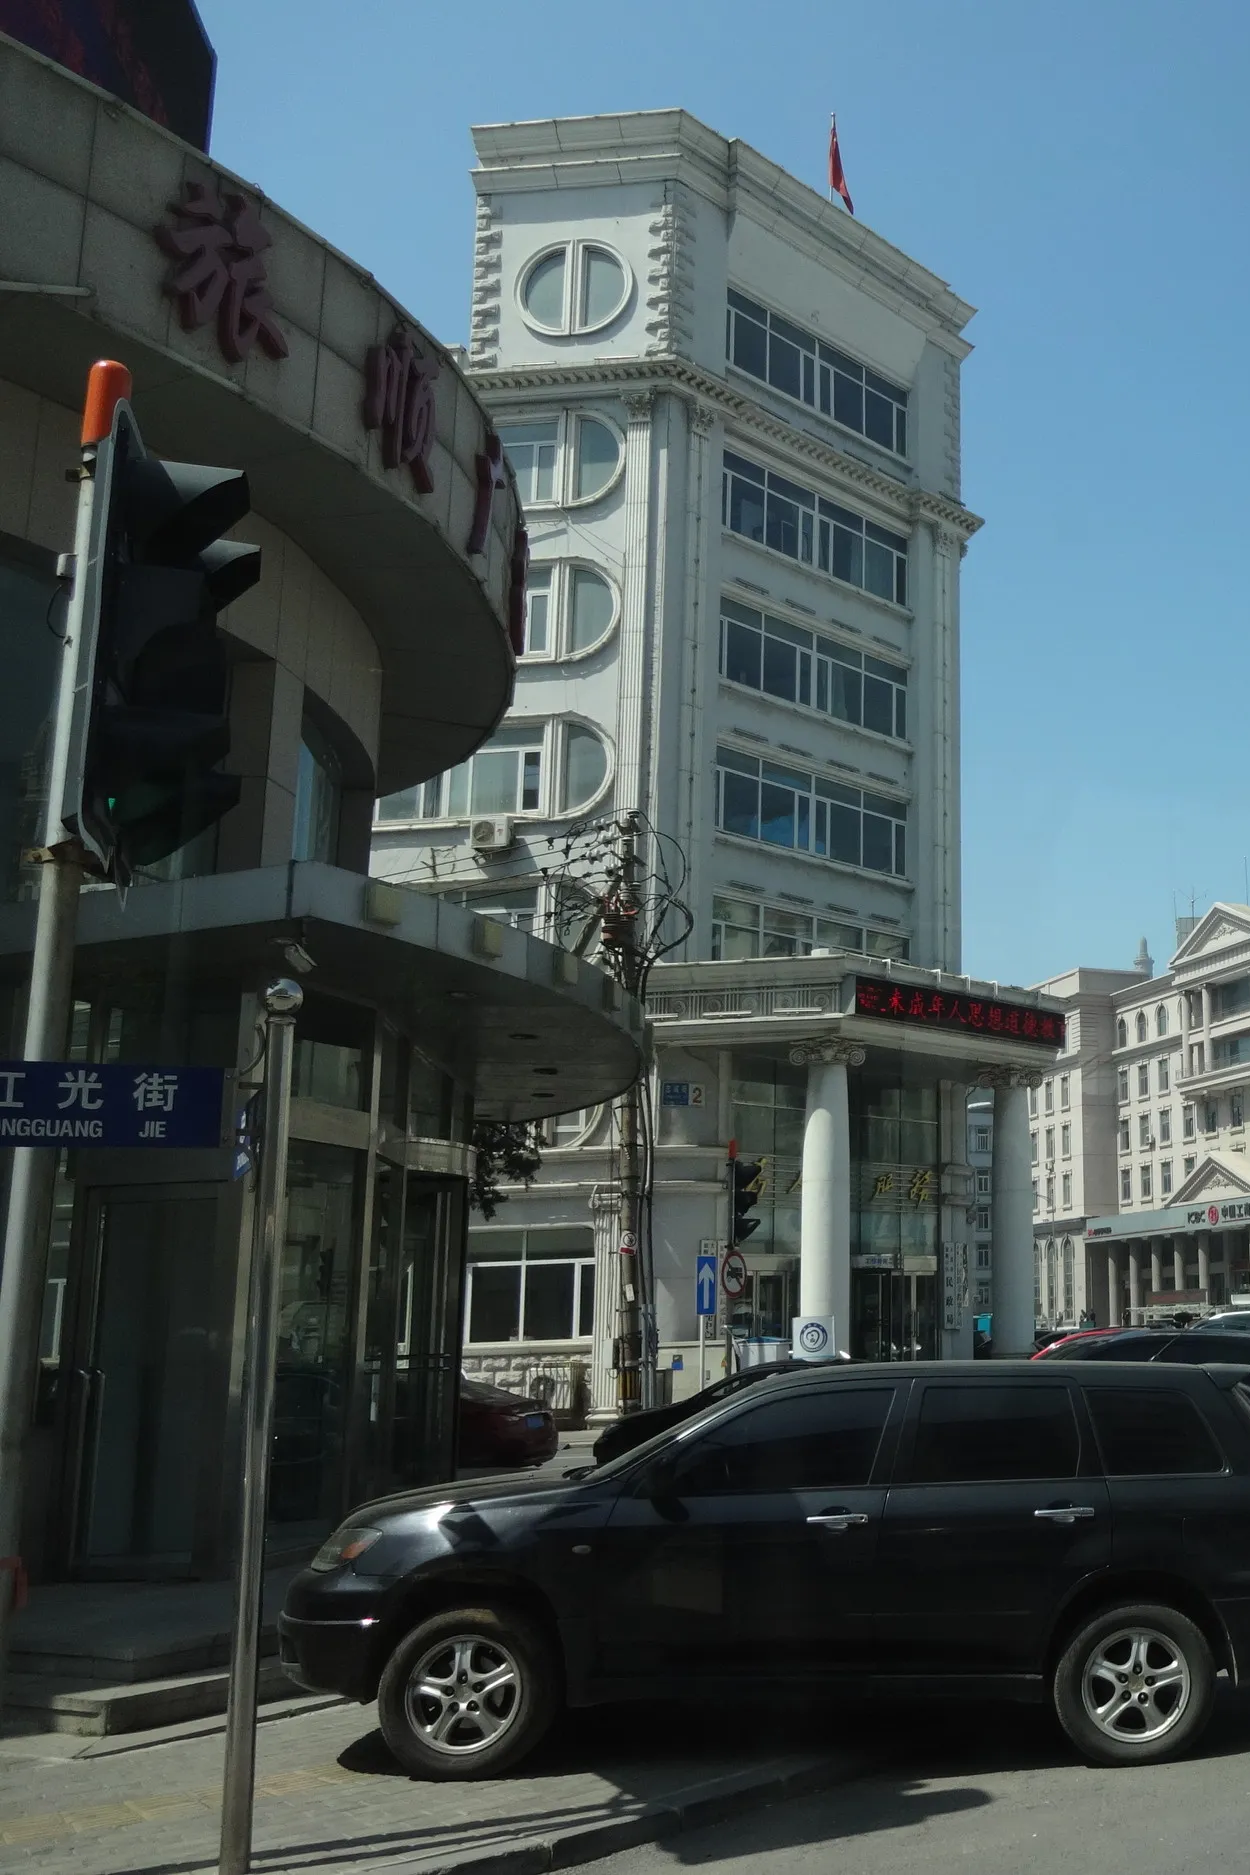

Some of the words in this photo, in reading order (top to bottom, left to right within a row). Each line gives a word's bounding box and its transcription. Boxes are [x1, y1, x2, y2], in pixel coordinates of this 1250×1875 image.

[692, 1087, 702, 1104] 2
[0, 1118, 103, 1138] NGGUANG
[138, 1121, 167, 1138] JIE
